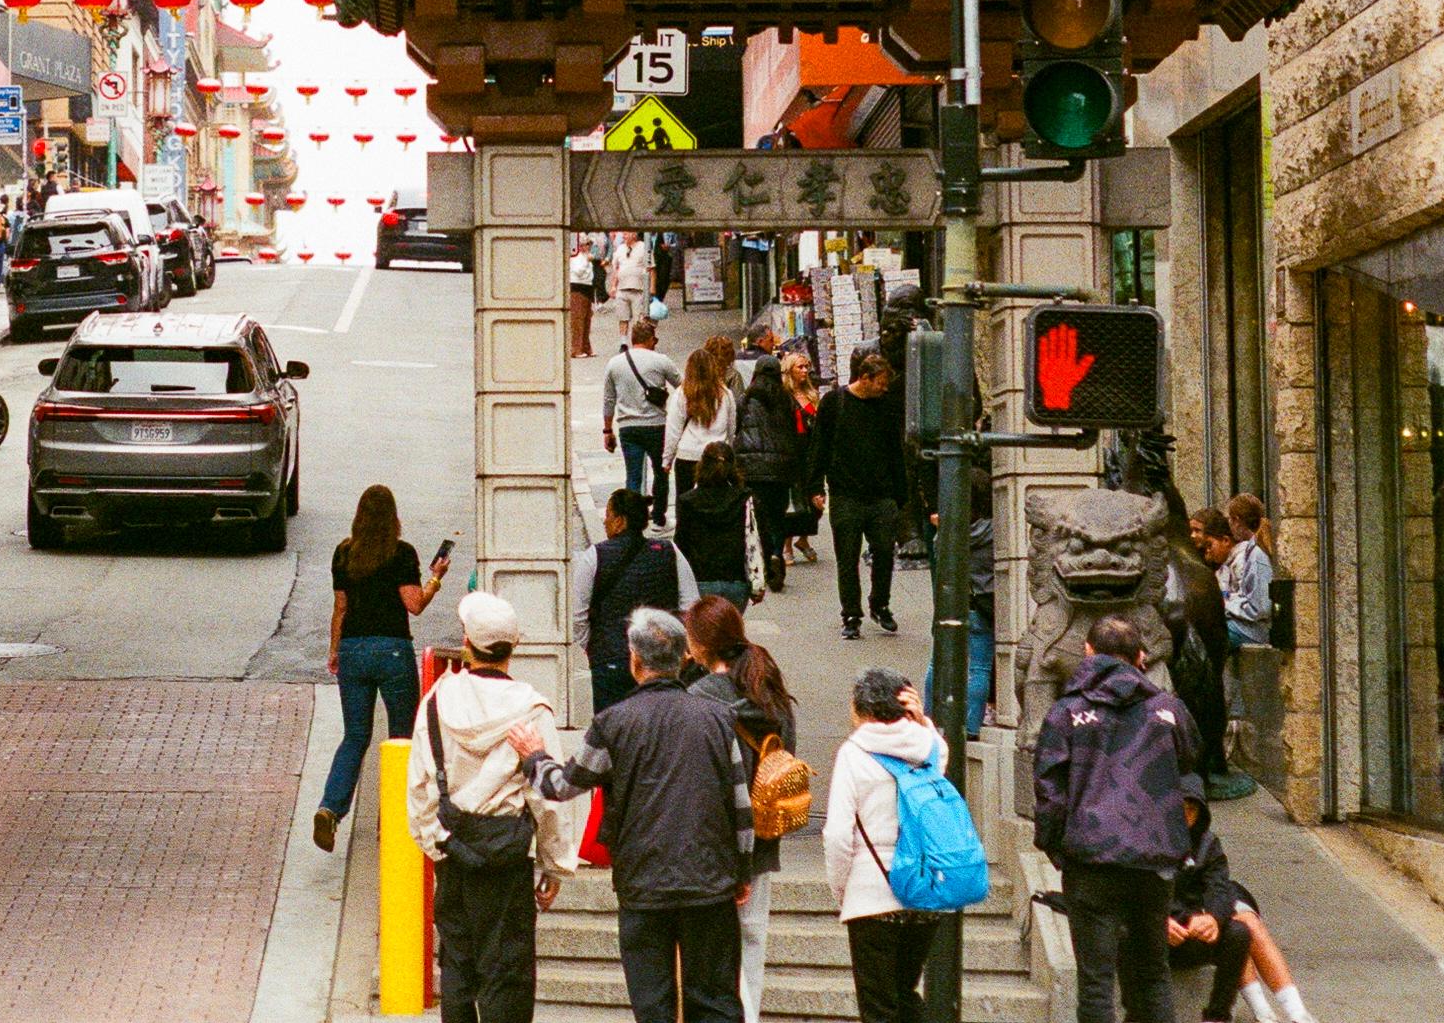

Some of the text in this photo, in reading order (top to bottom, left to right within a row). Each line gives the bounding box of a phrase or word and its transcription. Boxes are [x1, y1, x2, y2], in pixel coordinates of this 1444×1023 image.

[701, 36, 727, 48] Ship
[19, 51, 83, 84] GRANT PLAZA
[632, 52, 674, 84] 15
